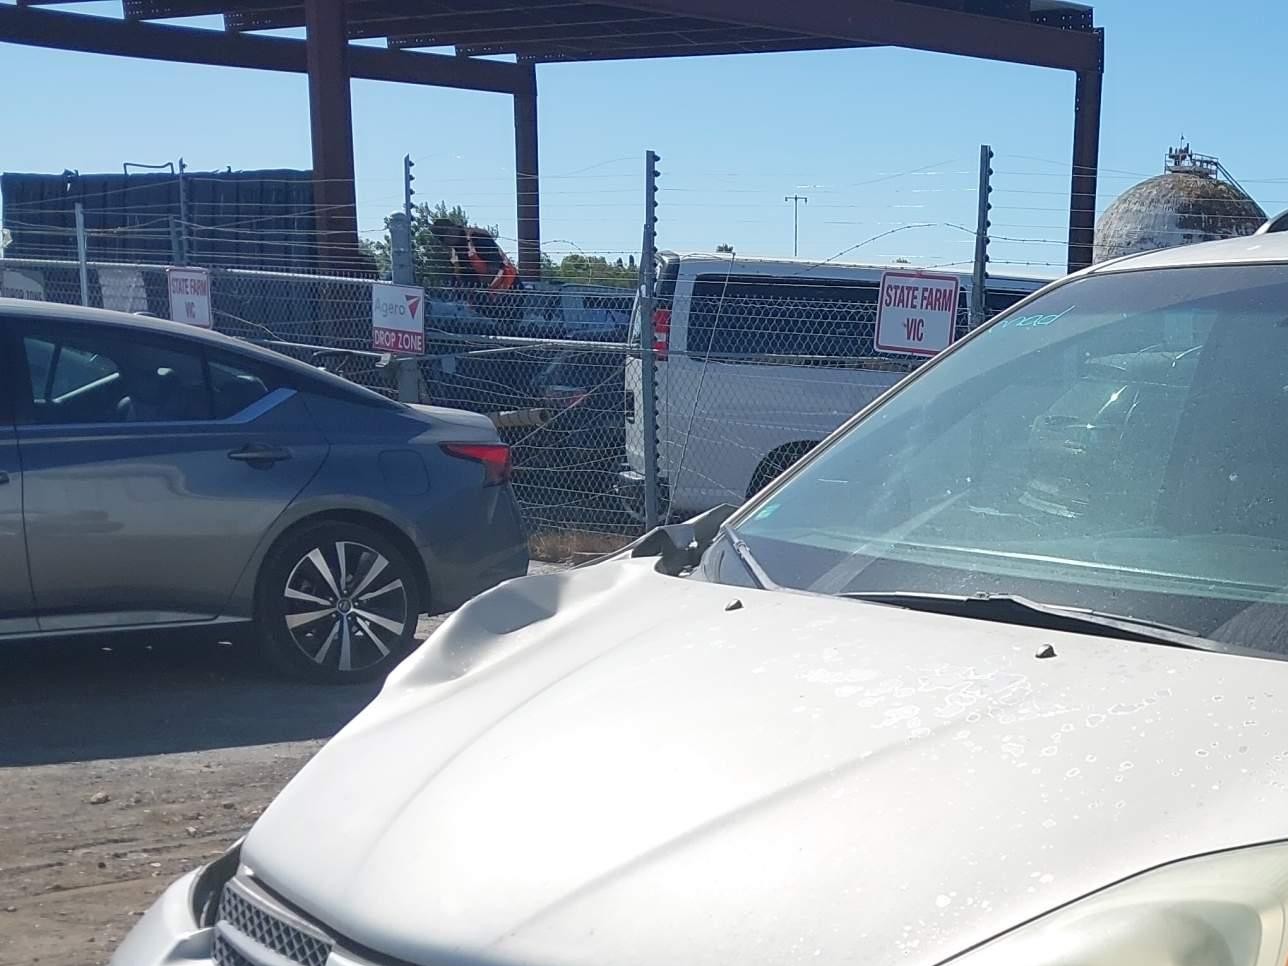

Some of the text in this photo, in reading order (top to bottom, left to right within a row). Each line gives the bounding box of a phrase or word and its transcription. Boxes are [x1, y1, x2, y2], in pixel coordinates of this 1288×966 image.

[172, 278, 207, 296] STATE FARM
[375, 297, 406, 317] Agero
[885, 285, 953, 312] STATE FARM
[185, 301, 196, 319] VIC
[905, 318, 924, 342] VIC
[374, 330, 422, 351] DROP ZONE
